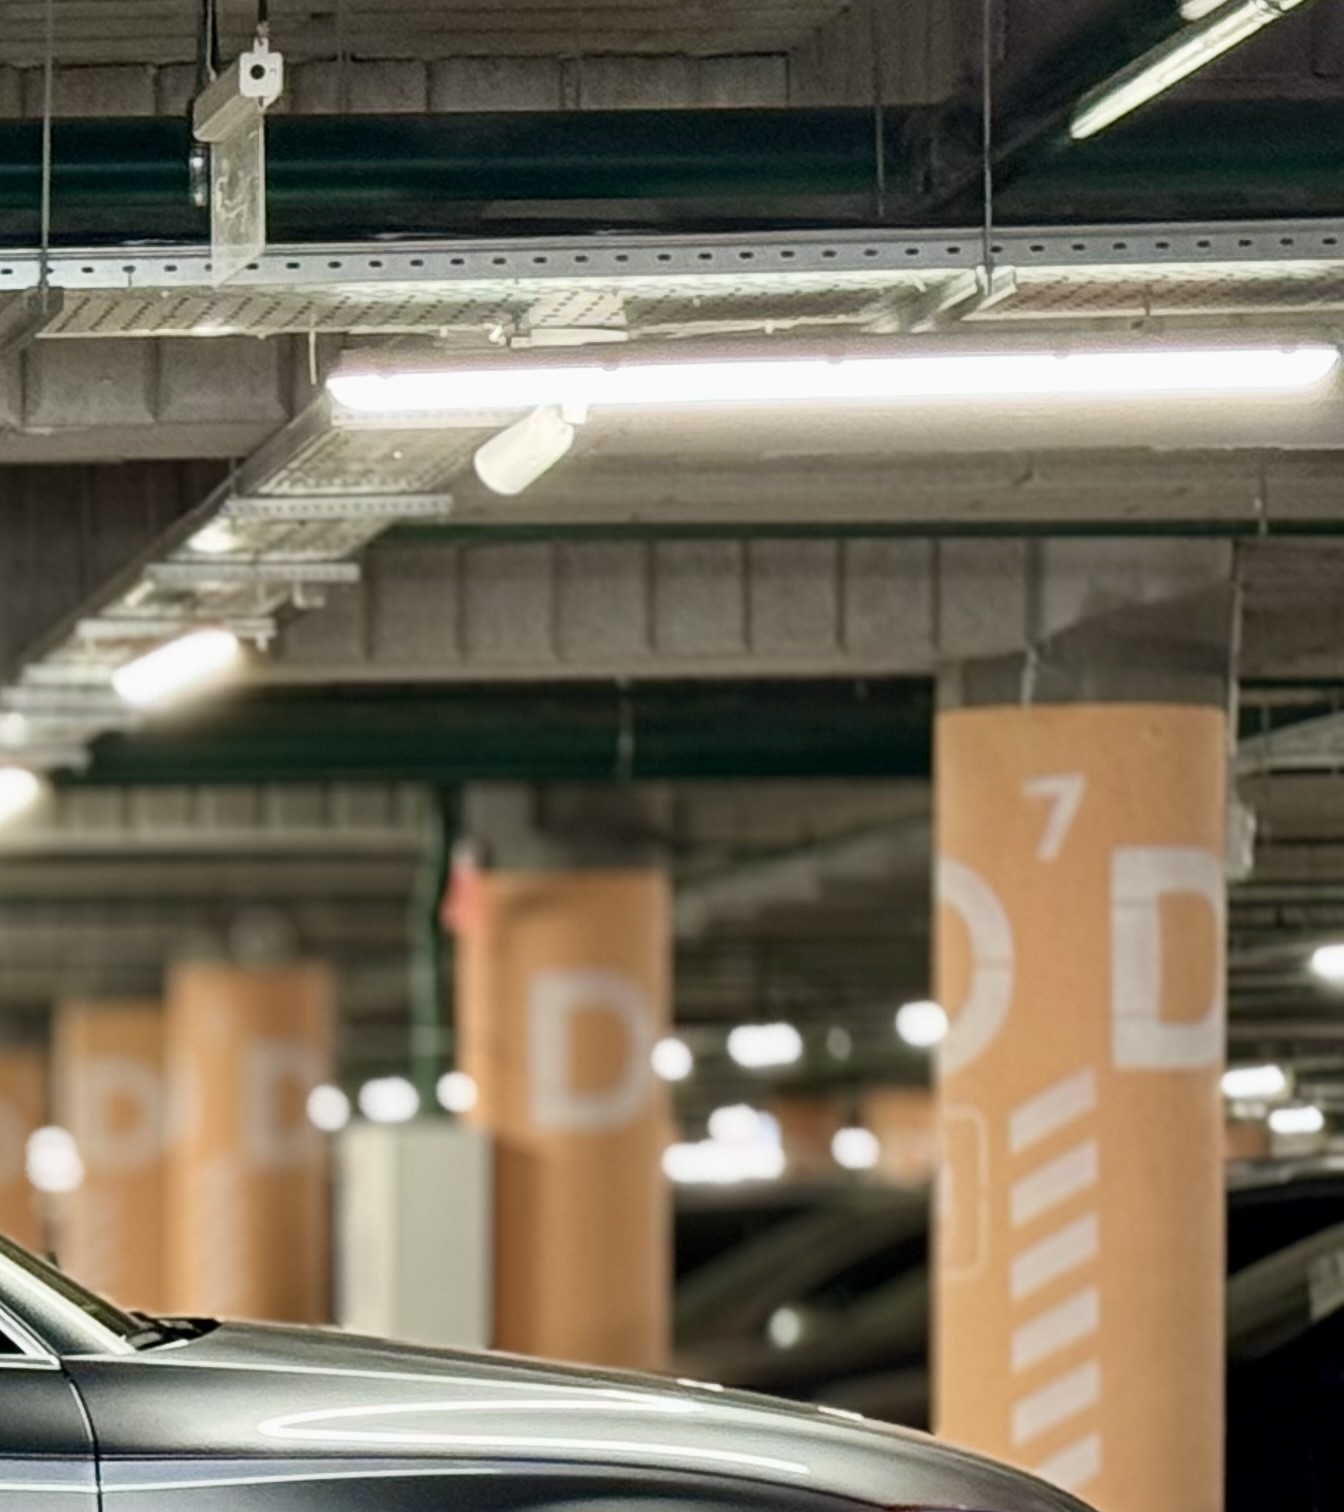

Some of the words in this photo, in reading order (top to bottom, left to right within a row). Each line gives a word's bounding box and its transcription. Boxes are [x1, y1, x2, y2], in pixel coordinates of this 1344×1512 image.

[1021, 772, 1086, 862] 7
[1110, 846, 1226, 1069] D
[527, 968, 658, 1134] D
